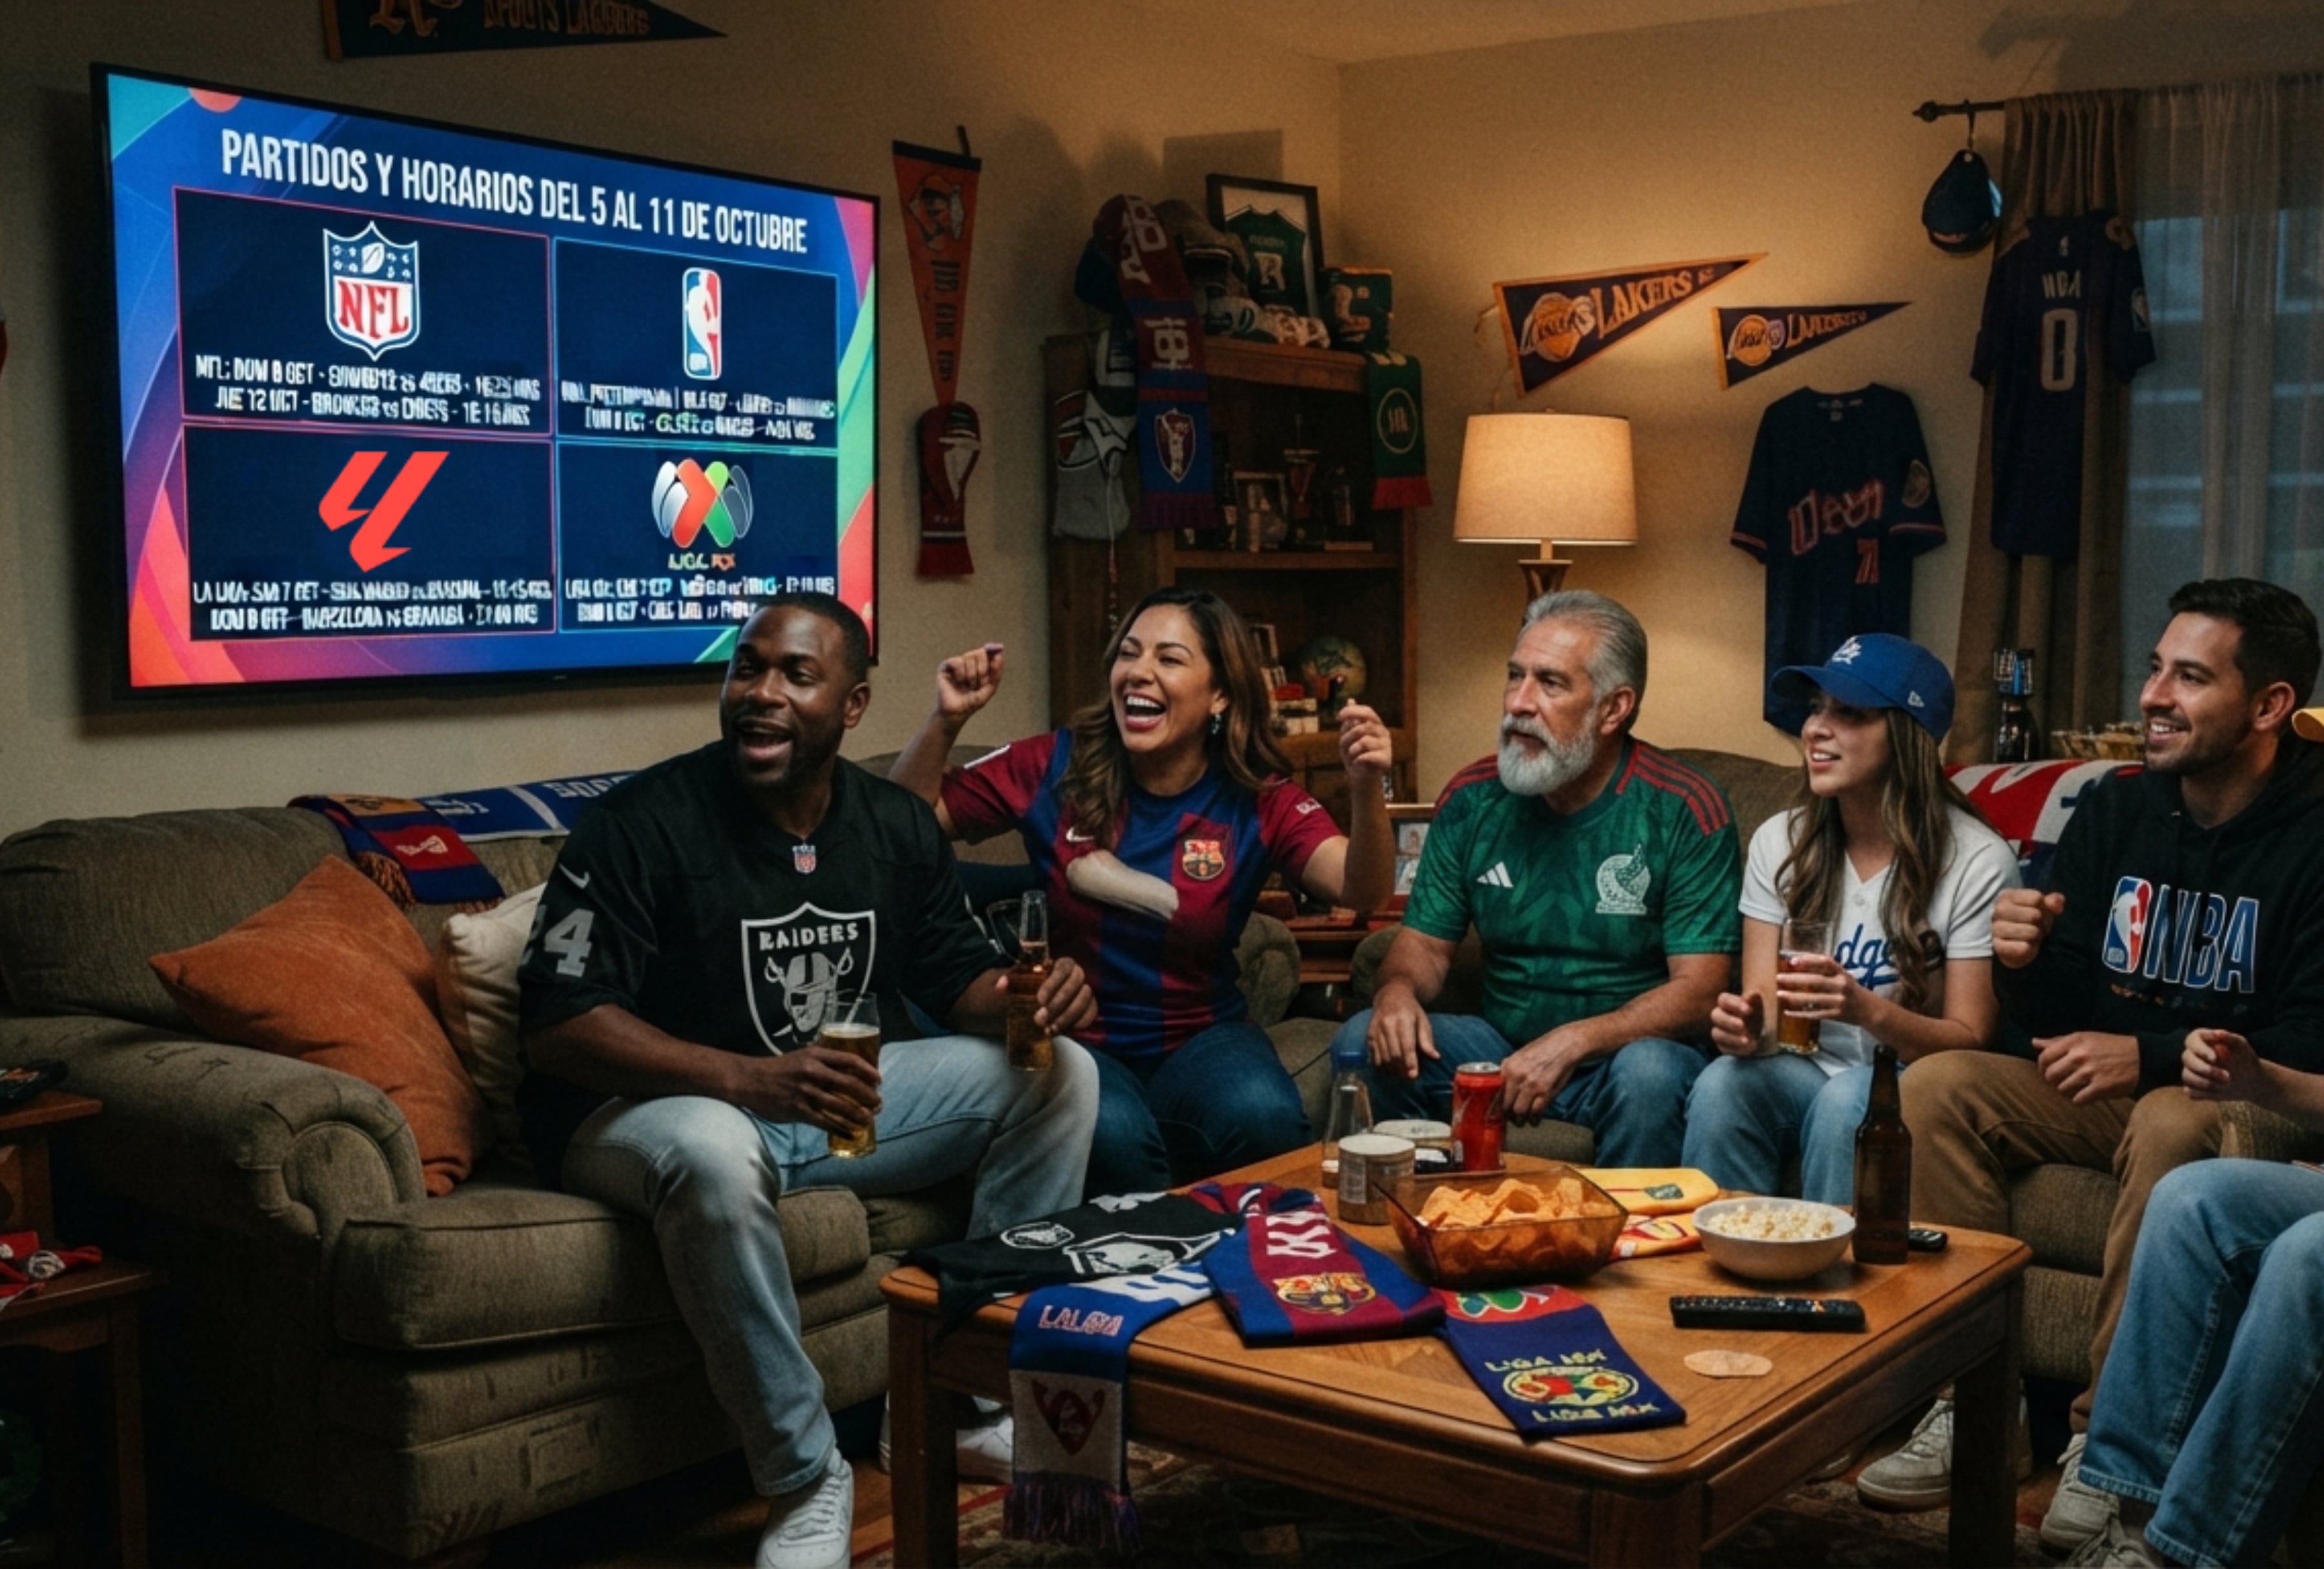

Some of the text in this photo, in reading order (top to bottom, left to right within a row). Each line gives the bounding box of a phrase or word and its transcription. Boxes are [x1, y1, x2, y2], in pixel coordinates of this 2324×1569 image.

[222, 128, 807, 253] PARTIDOS Y HORARIOS DEL 5 AL 11 DE OCTUBRE
[338, 279, 409, 340] NFL
[1589, 270, 1693, 340] LAKERS
[759, 922, 859, 951] RAIDERS
[2143, 883, 2260, 994] NBA
